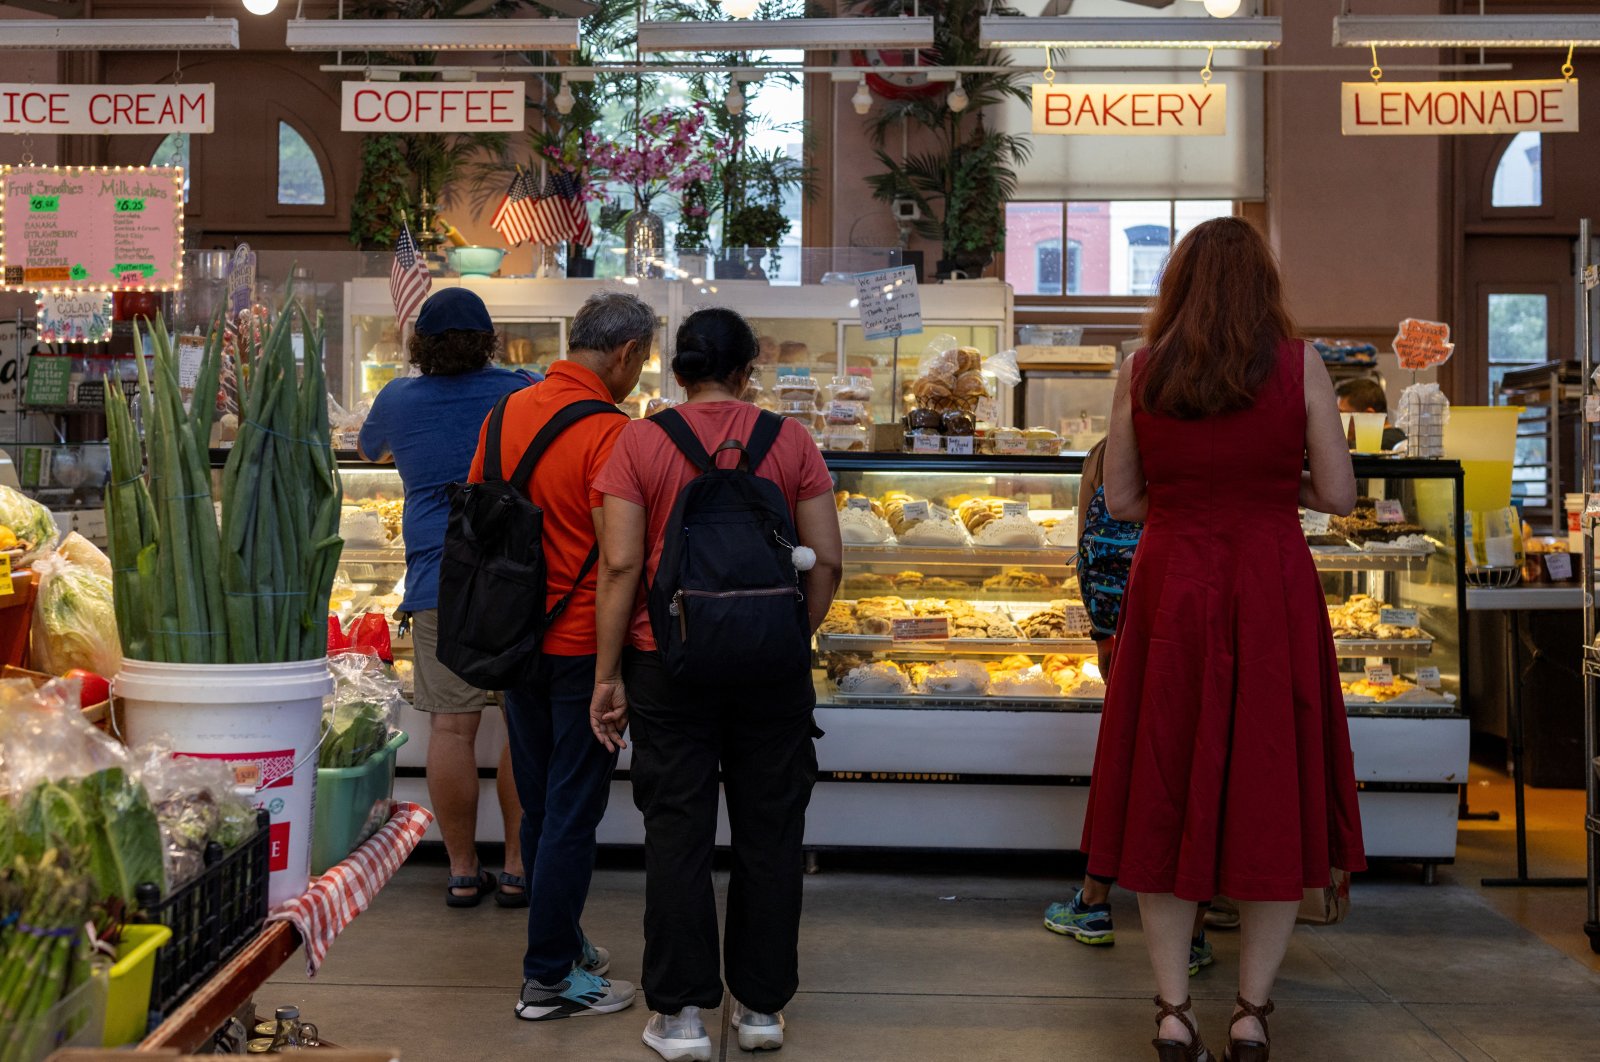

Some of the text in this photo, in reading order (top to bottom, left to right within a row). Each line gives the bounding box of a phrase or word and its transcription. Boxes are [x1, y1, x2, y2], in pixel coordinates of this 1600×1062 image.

[4, 92, 206, 125] ICE CREAM
[353, 89, 514, 124] COFFEE
[1044, 93, 1213, 127] BAKERY
[1354, 88, 1564, 126] LEMONADE
[24, 230, 79, 239] STRAWBERRY
[28, 240, 58, 248] LEMON
[28, 248, 57, 257] PEACH
[26, 258, 70, 266] PINEAPPLE
[858, 278, 870, 287] We
[57, 302, 100, 315] COLADA
[865, 308, 883, 317] Thank
